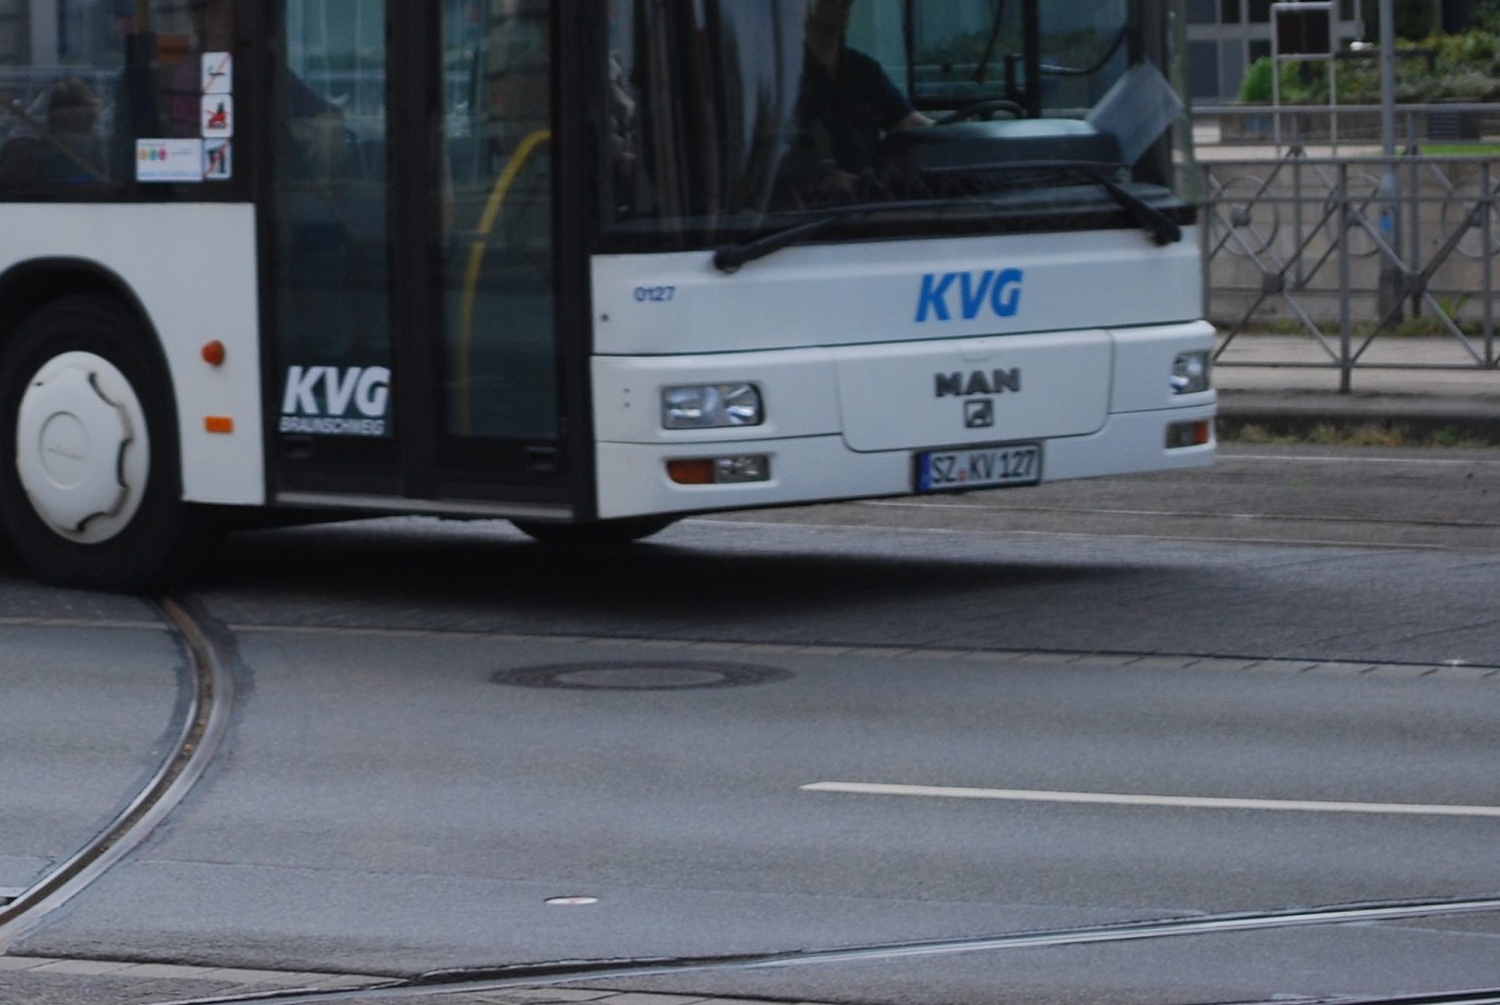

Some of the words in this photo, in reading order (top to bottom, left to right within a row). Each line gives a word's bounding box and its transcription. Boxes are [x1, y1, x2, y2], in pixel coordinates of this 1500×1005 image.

[634, 286, 676, 302] 0127
[914, 267, 1024, 322] KVG
[282, 365, 391, 416] KVG
[934, 367, 1021, 397] MAN
[280, 416, 385, 435] BRAUNSCHWEIG
[931, 455, 956, 483] SZ
[999, 449, 1036, 478] 127
